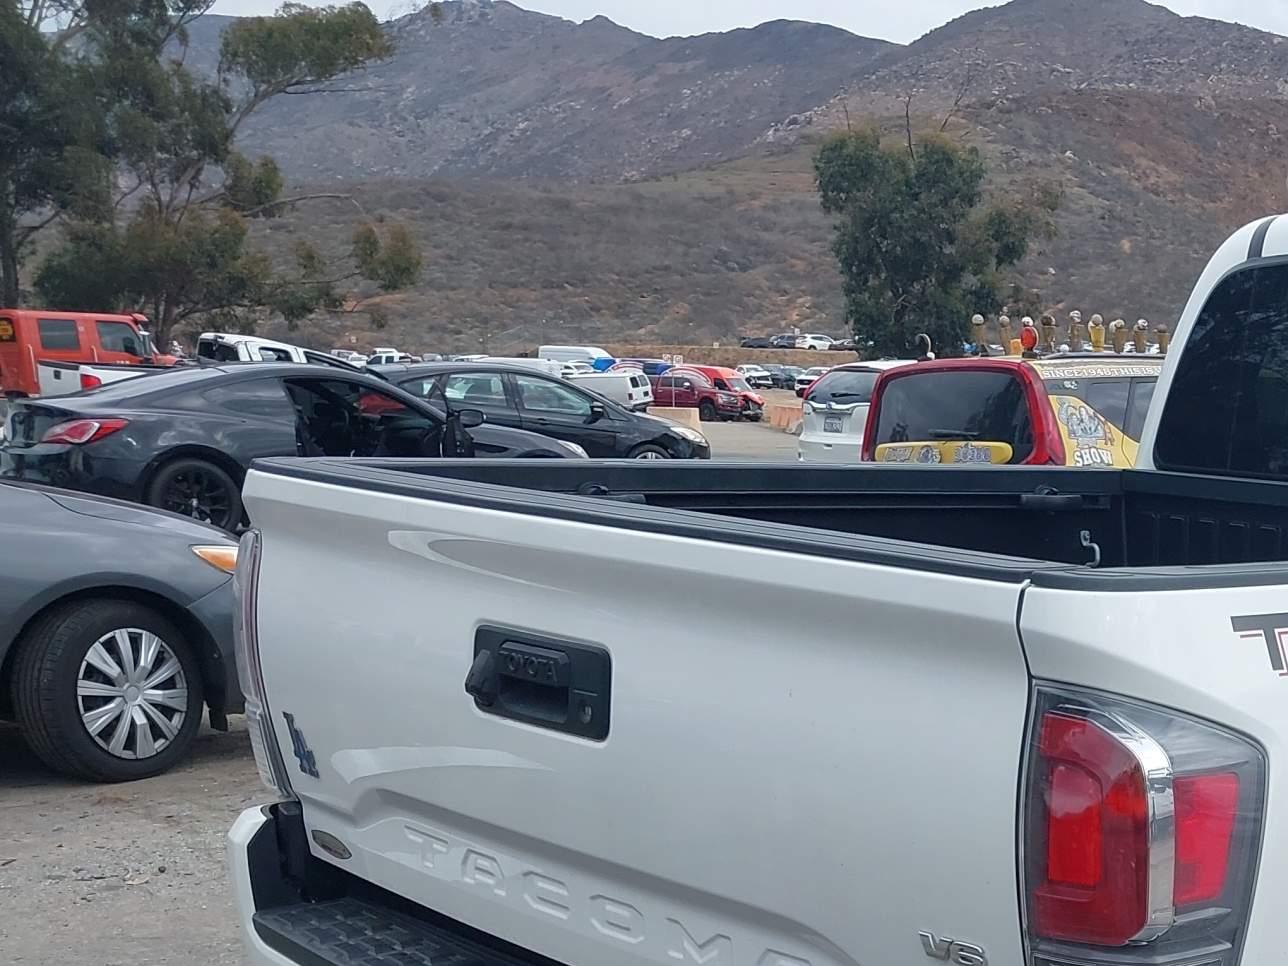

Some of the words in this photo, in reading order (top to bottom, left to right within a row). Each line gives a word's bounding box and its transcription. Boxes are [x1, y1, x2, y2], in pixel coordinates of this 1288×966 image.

[1043, 368, 1081, 379] SINCE
[1112, 367, 1140, 376] THIS
[1073, 447, 1114, 466] SHOW
[498, 650, 560, 683] TOYOTA
